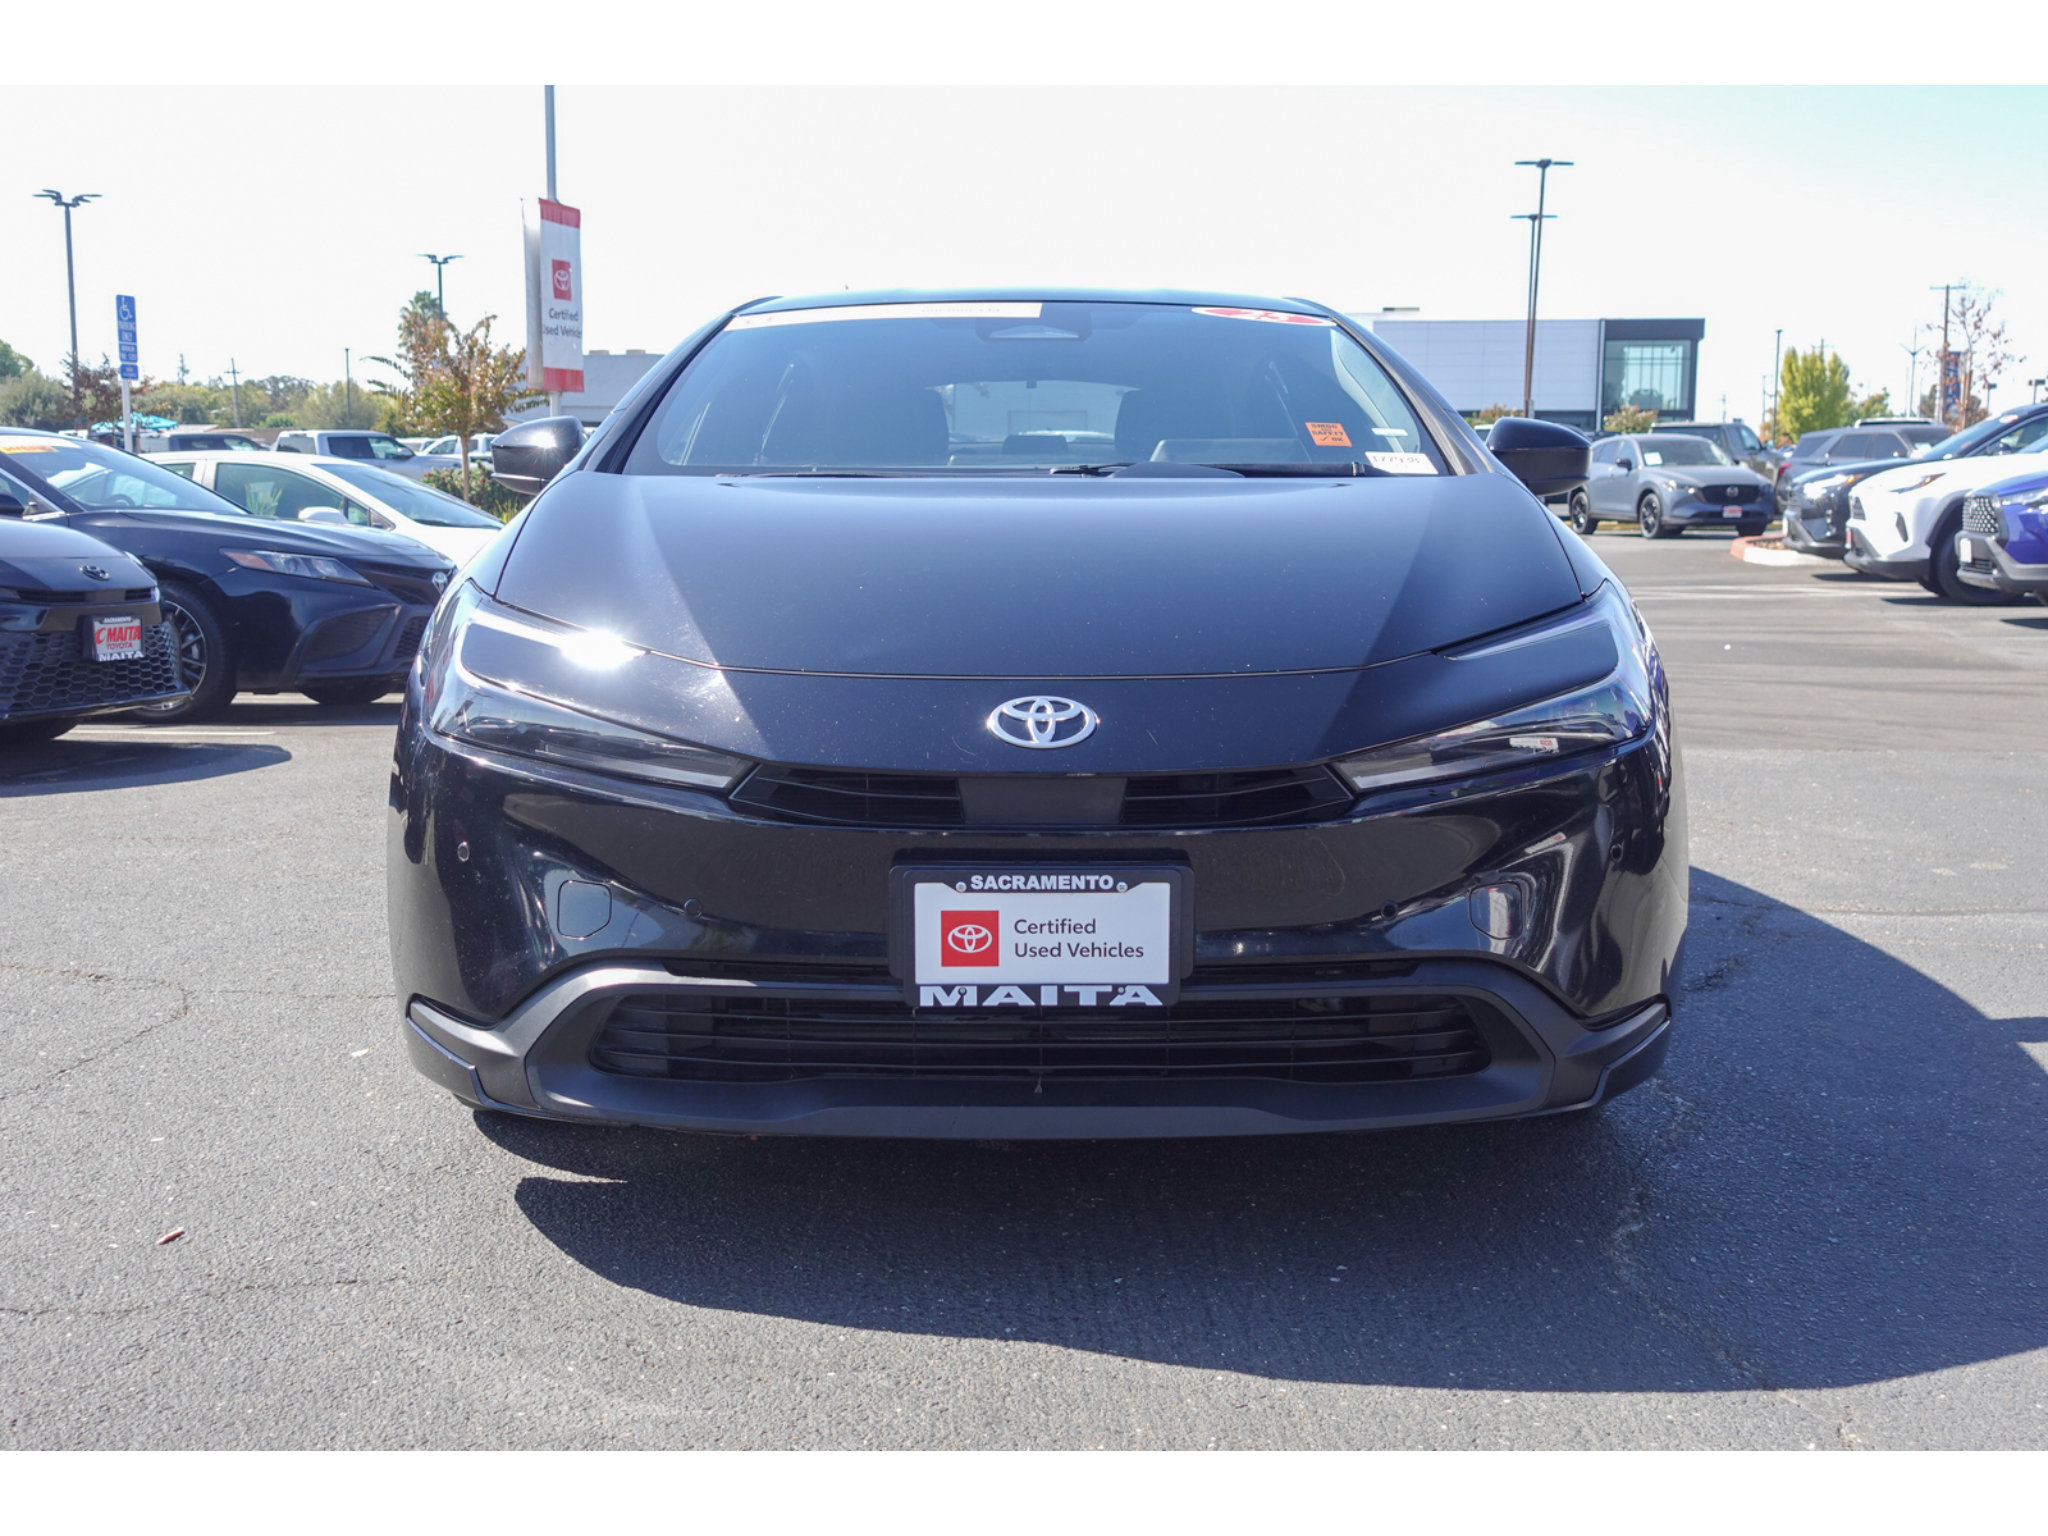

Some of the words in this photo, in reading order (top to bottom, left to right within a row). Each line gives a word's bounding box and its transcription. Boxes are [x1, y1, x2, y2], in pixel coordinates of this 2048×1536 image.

[106, 625, 141, 642] MAITA
[970, 875, 1114, 890] SACRAMENTO
[1014, 918, 1096, 934] Certified
[1014, 942, 1061, 958] Used
[1067, 942, 1144, 958] Vehicles
[920, 985, 1163, 1006] MAITA
